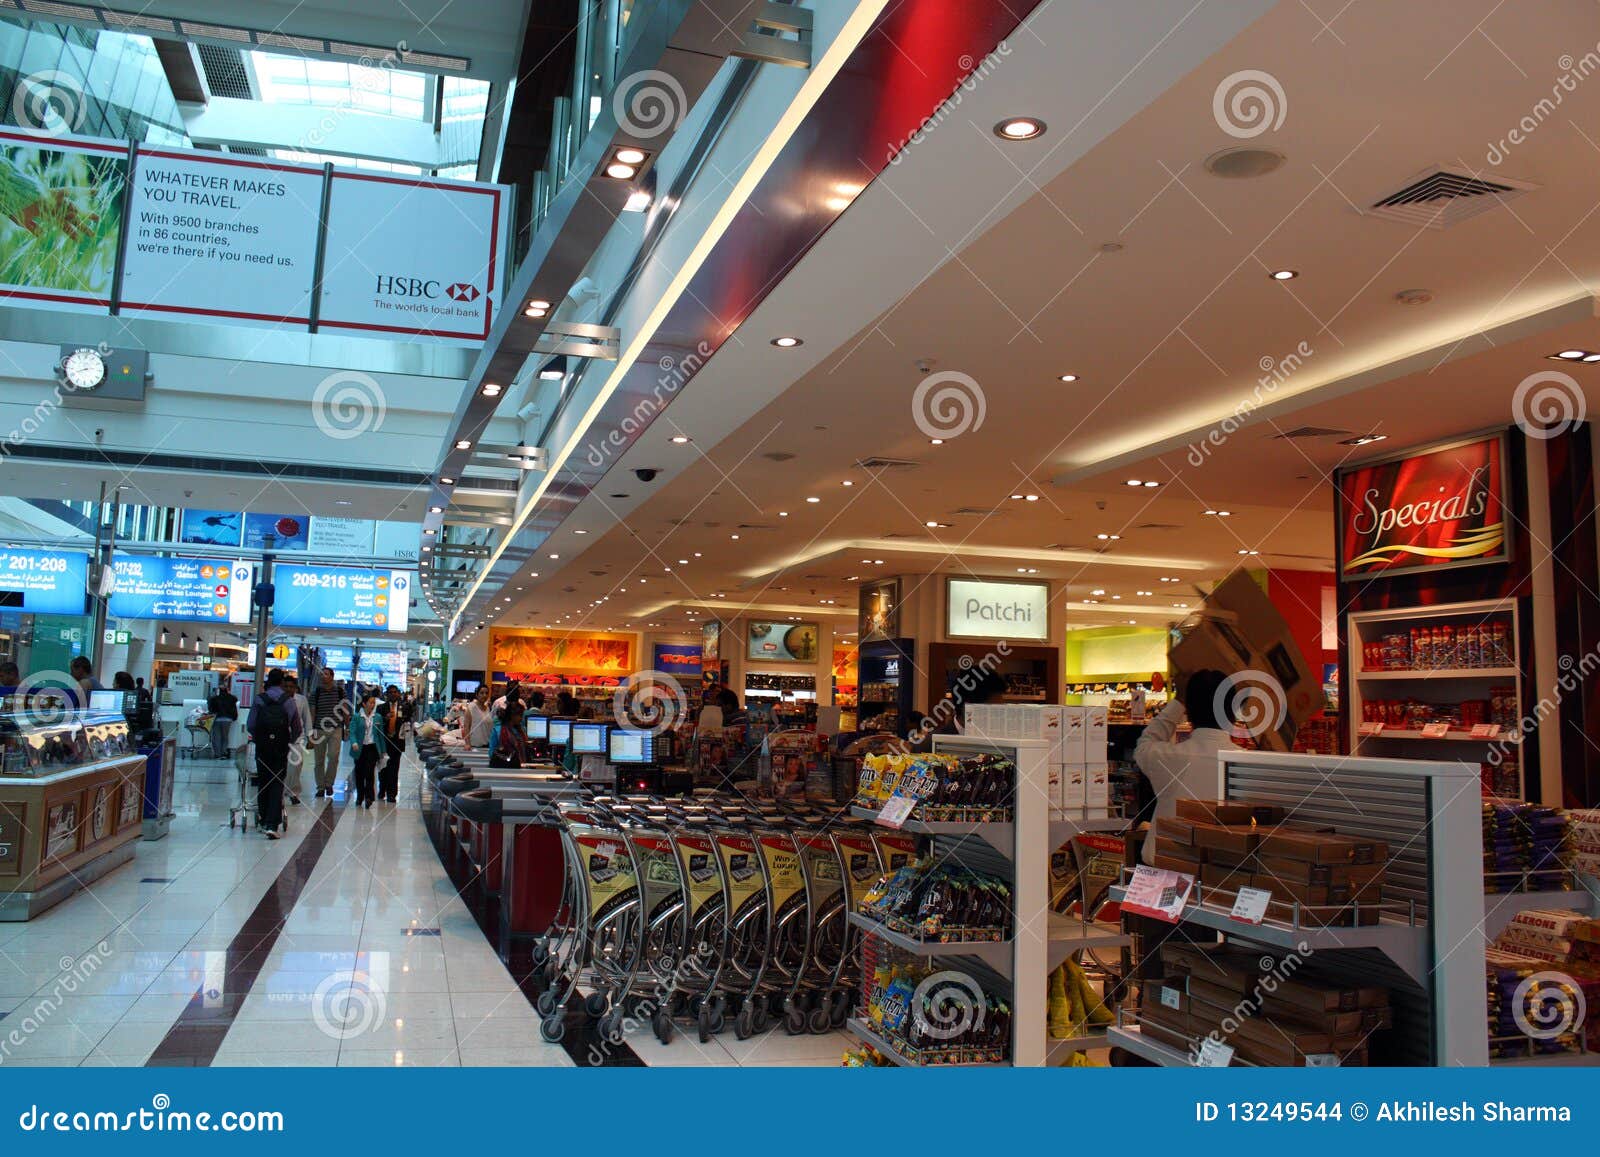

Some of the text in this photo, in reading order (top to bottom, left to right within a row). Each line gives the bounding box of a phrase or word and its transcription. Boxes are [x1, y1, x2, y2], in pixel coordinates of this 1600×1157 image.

[145, 169, 286, 197] WHATEVER MAKES
[144, 187, 241, 210] YOU TRAVEL.
[140, 212, 259, 234] With 9500 branches
[139, 226, 231, 247] in 86 countries,
[137, 243, 294, 267] we're there if you need us.
[375, 275, 440, 299] HSBC
[374, 300, 480, 318] The world's local bank
[1353, 467, 1488, 549] Specials
[394, 550, 417, 559] HSBC
[9, 556, 67, 572] 201-208
[176, 571, 198, 579] Gates
[292, 573, 347, 589] 209-216
[166, 589, 184, 597] Class
[185, 591, 213, 599] Lounges
[196, 609, 212, 617] Club
[965, 597, 1032, 623] Patchi
[320, 617, 349, 625] Business
[564, 675, 620, 687] TOYS
[773, 862, 798, 870] Luxury
